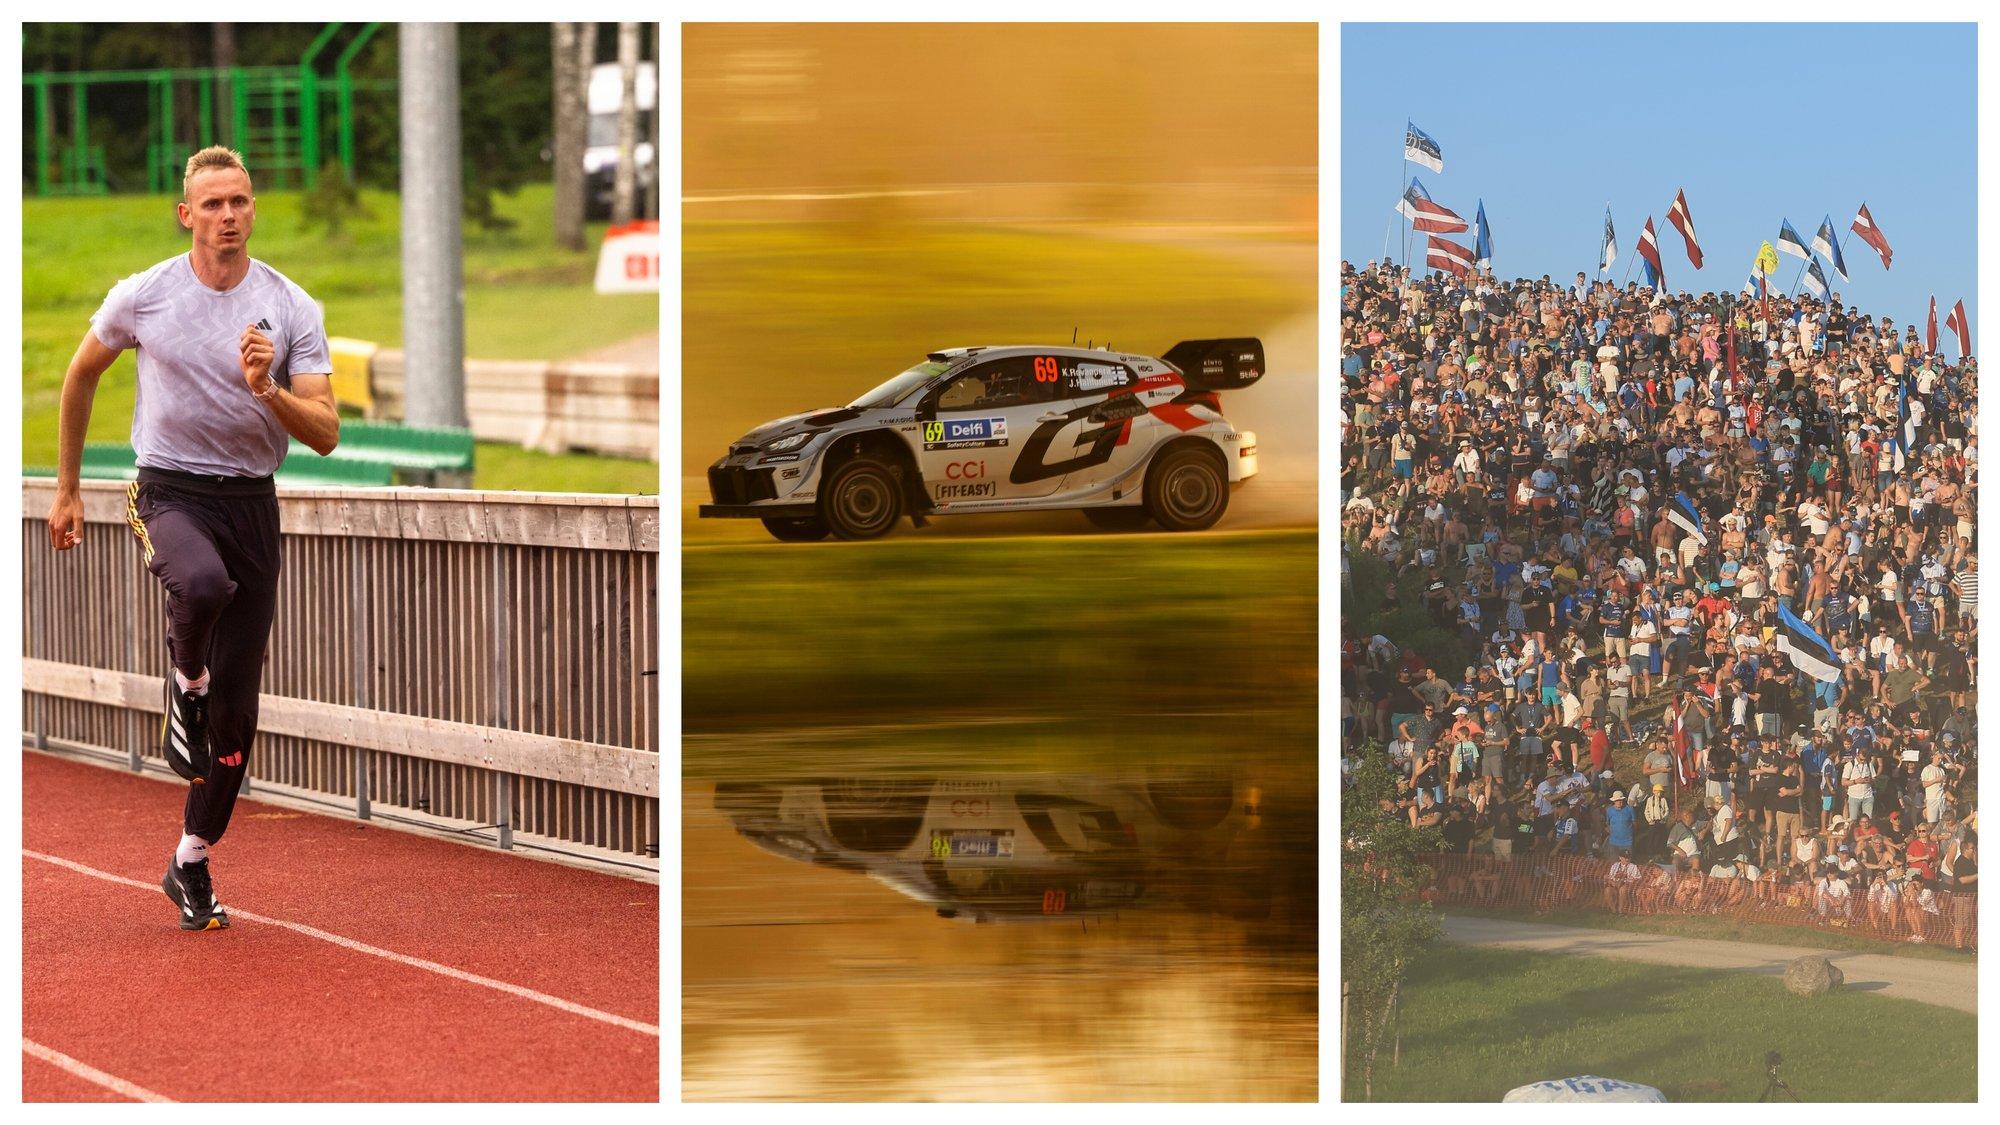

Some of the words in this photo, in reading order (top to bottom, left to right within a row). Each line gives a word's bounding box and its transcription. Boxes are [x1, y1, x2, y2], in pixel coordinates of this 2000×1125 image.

[1034, 356, 1058, 383] 69
[926, 422, 943, 442] 69
[952, 423, 983, 436] Delfi
